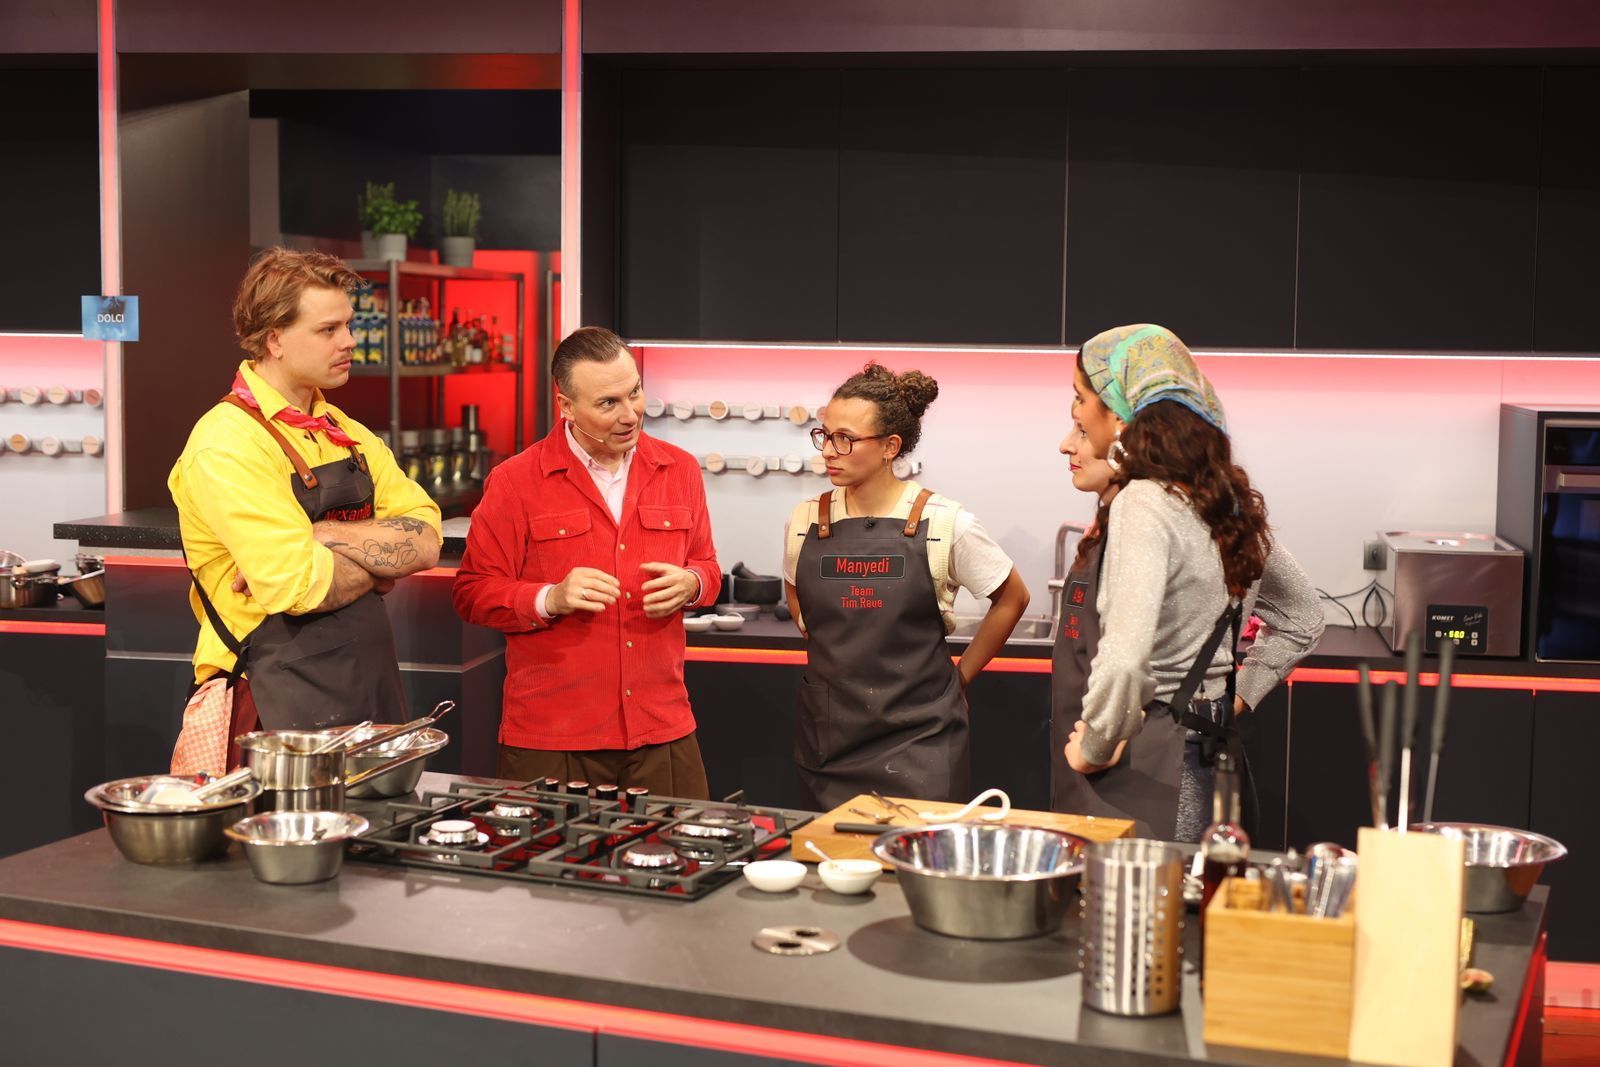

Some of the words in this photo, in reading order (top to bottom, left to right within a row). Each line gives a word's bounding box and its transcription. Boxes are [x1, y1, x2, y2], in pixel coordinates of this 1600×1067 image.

[97, 313, 124, 323] DOLCI
[835, 557, 890, 577] Manyedi
[850, 585, 874, 596] Team
[841, 596, 857, 608] Tim
[860, 597, 884, 608] Raue
